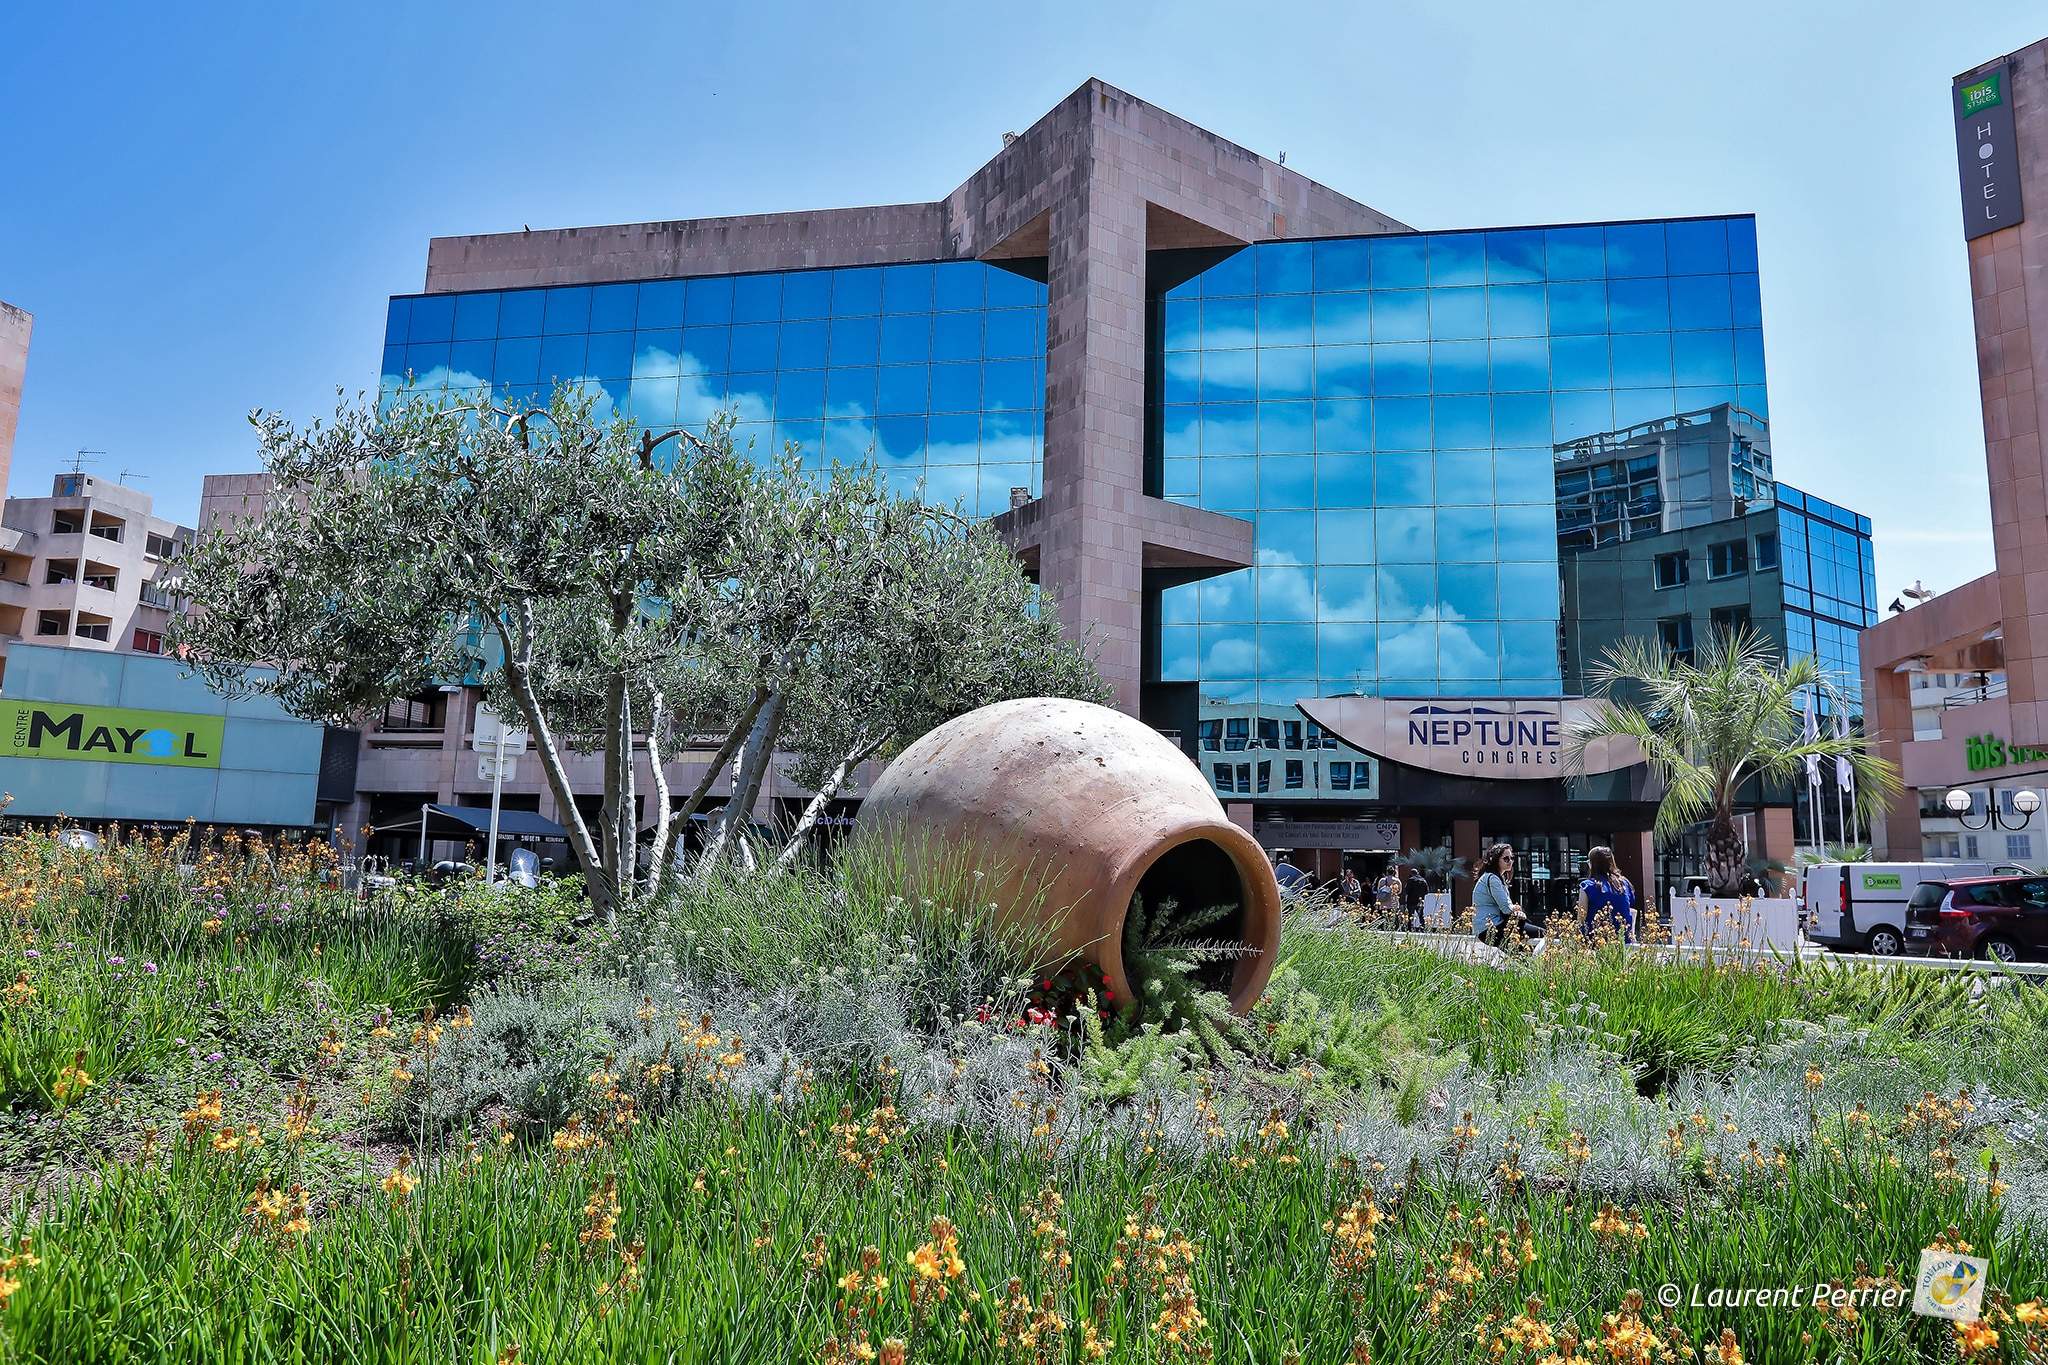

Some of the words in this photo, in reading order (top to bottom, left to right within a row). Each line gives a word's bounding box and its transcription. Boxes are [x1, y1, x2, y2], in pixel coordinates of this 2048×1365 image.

[1969, 86, 1992, 101] ibis
[1977, 121, 1998, 220] HOTEL
[13, 708, 30, 748] CENTRE
[1409, 720, 1561, 746] NEPTUNE
[1462, 750, 1558, 765] CONGRES
[1965, 733, 2006, 772] ibis
